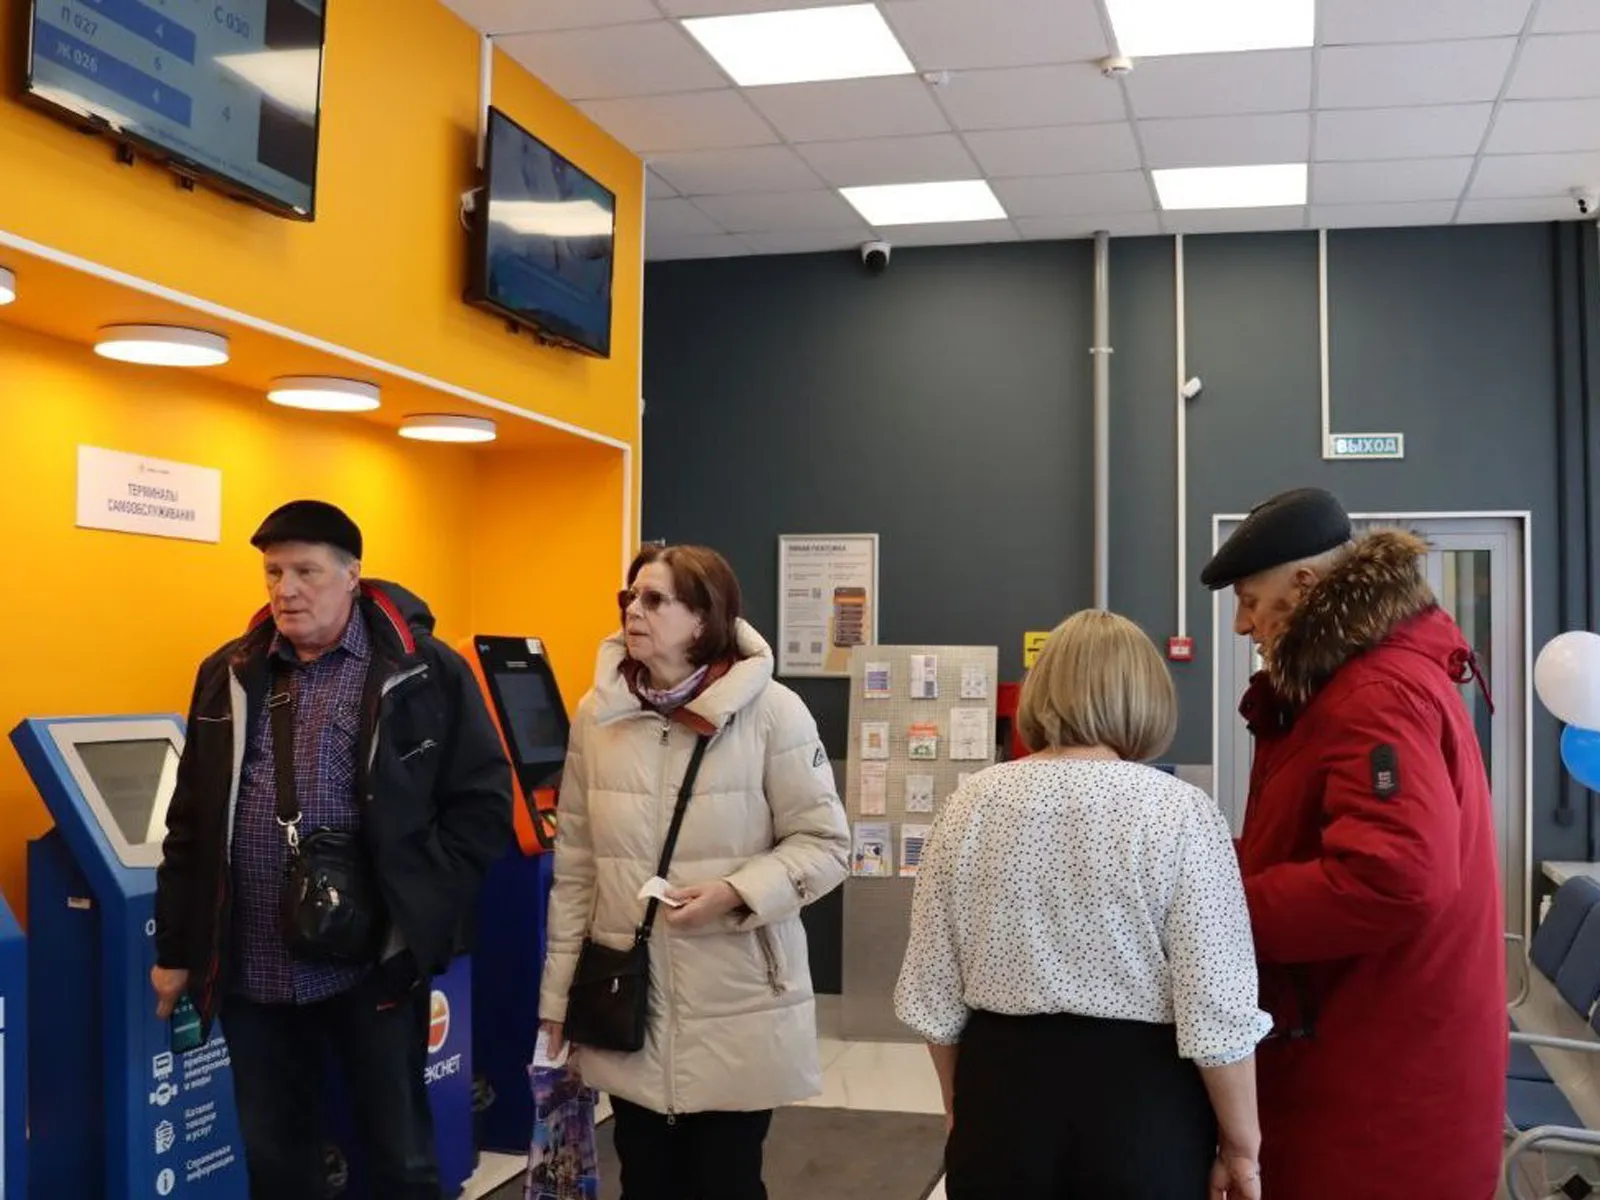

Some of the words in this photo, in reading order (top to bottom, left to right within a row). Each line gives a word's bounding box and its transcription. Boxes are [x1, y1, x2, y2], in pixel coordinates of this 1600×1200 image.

[1336, 437, 1397, 454] ВЫХОД
[127, 483, 179, 503] ТЕРМИНАЛЫ
[107, 498, 196, 522] САМООБСЛУЖИВАНИЯ
